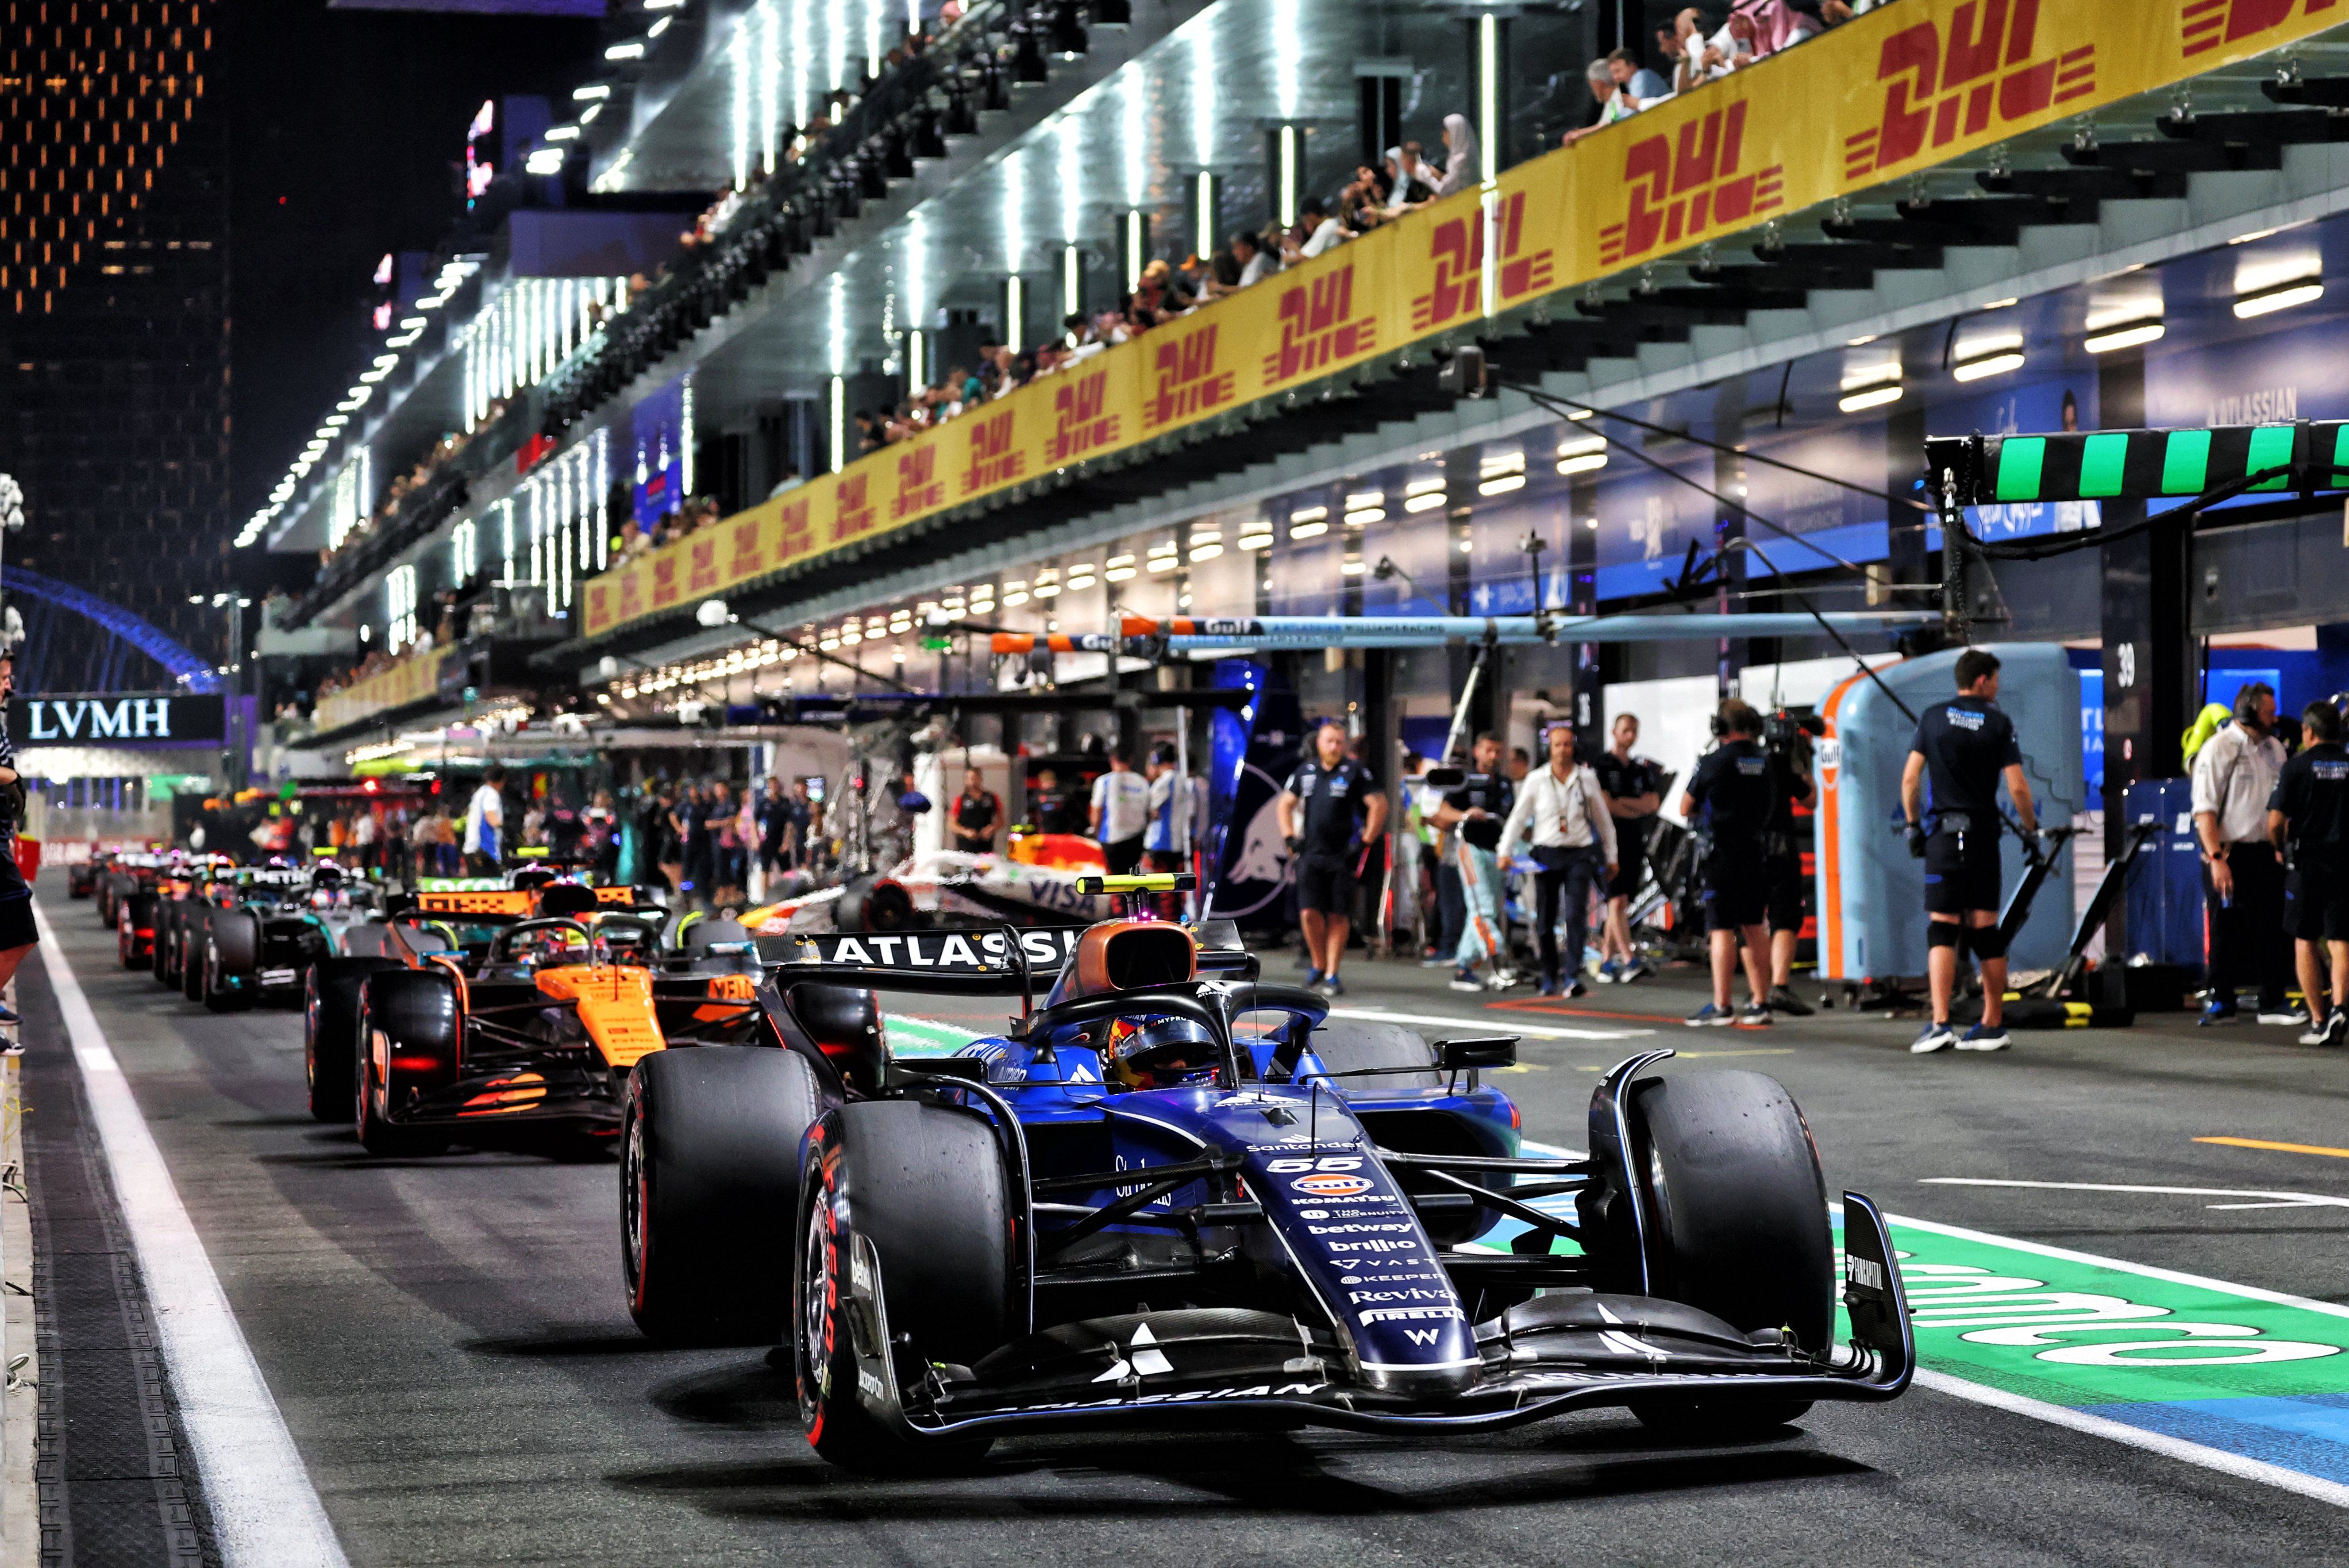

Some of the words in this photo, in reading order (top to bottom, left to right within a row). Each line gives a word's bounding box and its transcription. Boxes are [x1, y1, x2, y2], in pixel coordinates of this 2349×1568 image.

[1876, 0, 2057, 168] DHL
[1624, 99, 1755, 257] DHL
[1431, 191, 1532, 324] DHL
[1279, 264, 1360, 380] DHL
[1156, 323, 1219, 424] DHL
[1055, 369, 1108, 459] DHL
[28, 698, 171, 740] LVMH
[1029, 880, 1095, 912] VISA
[833, 930, 1077, 965] ATLASSI
[1246, 1142, 1364, 1152] Santander
[1266, 1157, 1364, 1173] 55
[1296, 1180, 1366, 1189] Gulf
[1291, 1195, 1396, 1205] KOMATSU
[1308, 1223, 1412, 1234] betway
[1328, 1239, 1416, 1252] brillio
[1367, 1258, 1436, 1266] VAST
[1364, 1273, 1447, 1282] KEEPER
[1349, 1288, 1458, 1305] Reviva
[1358, 1306, 1466, 1327] PIRELLI
